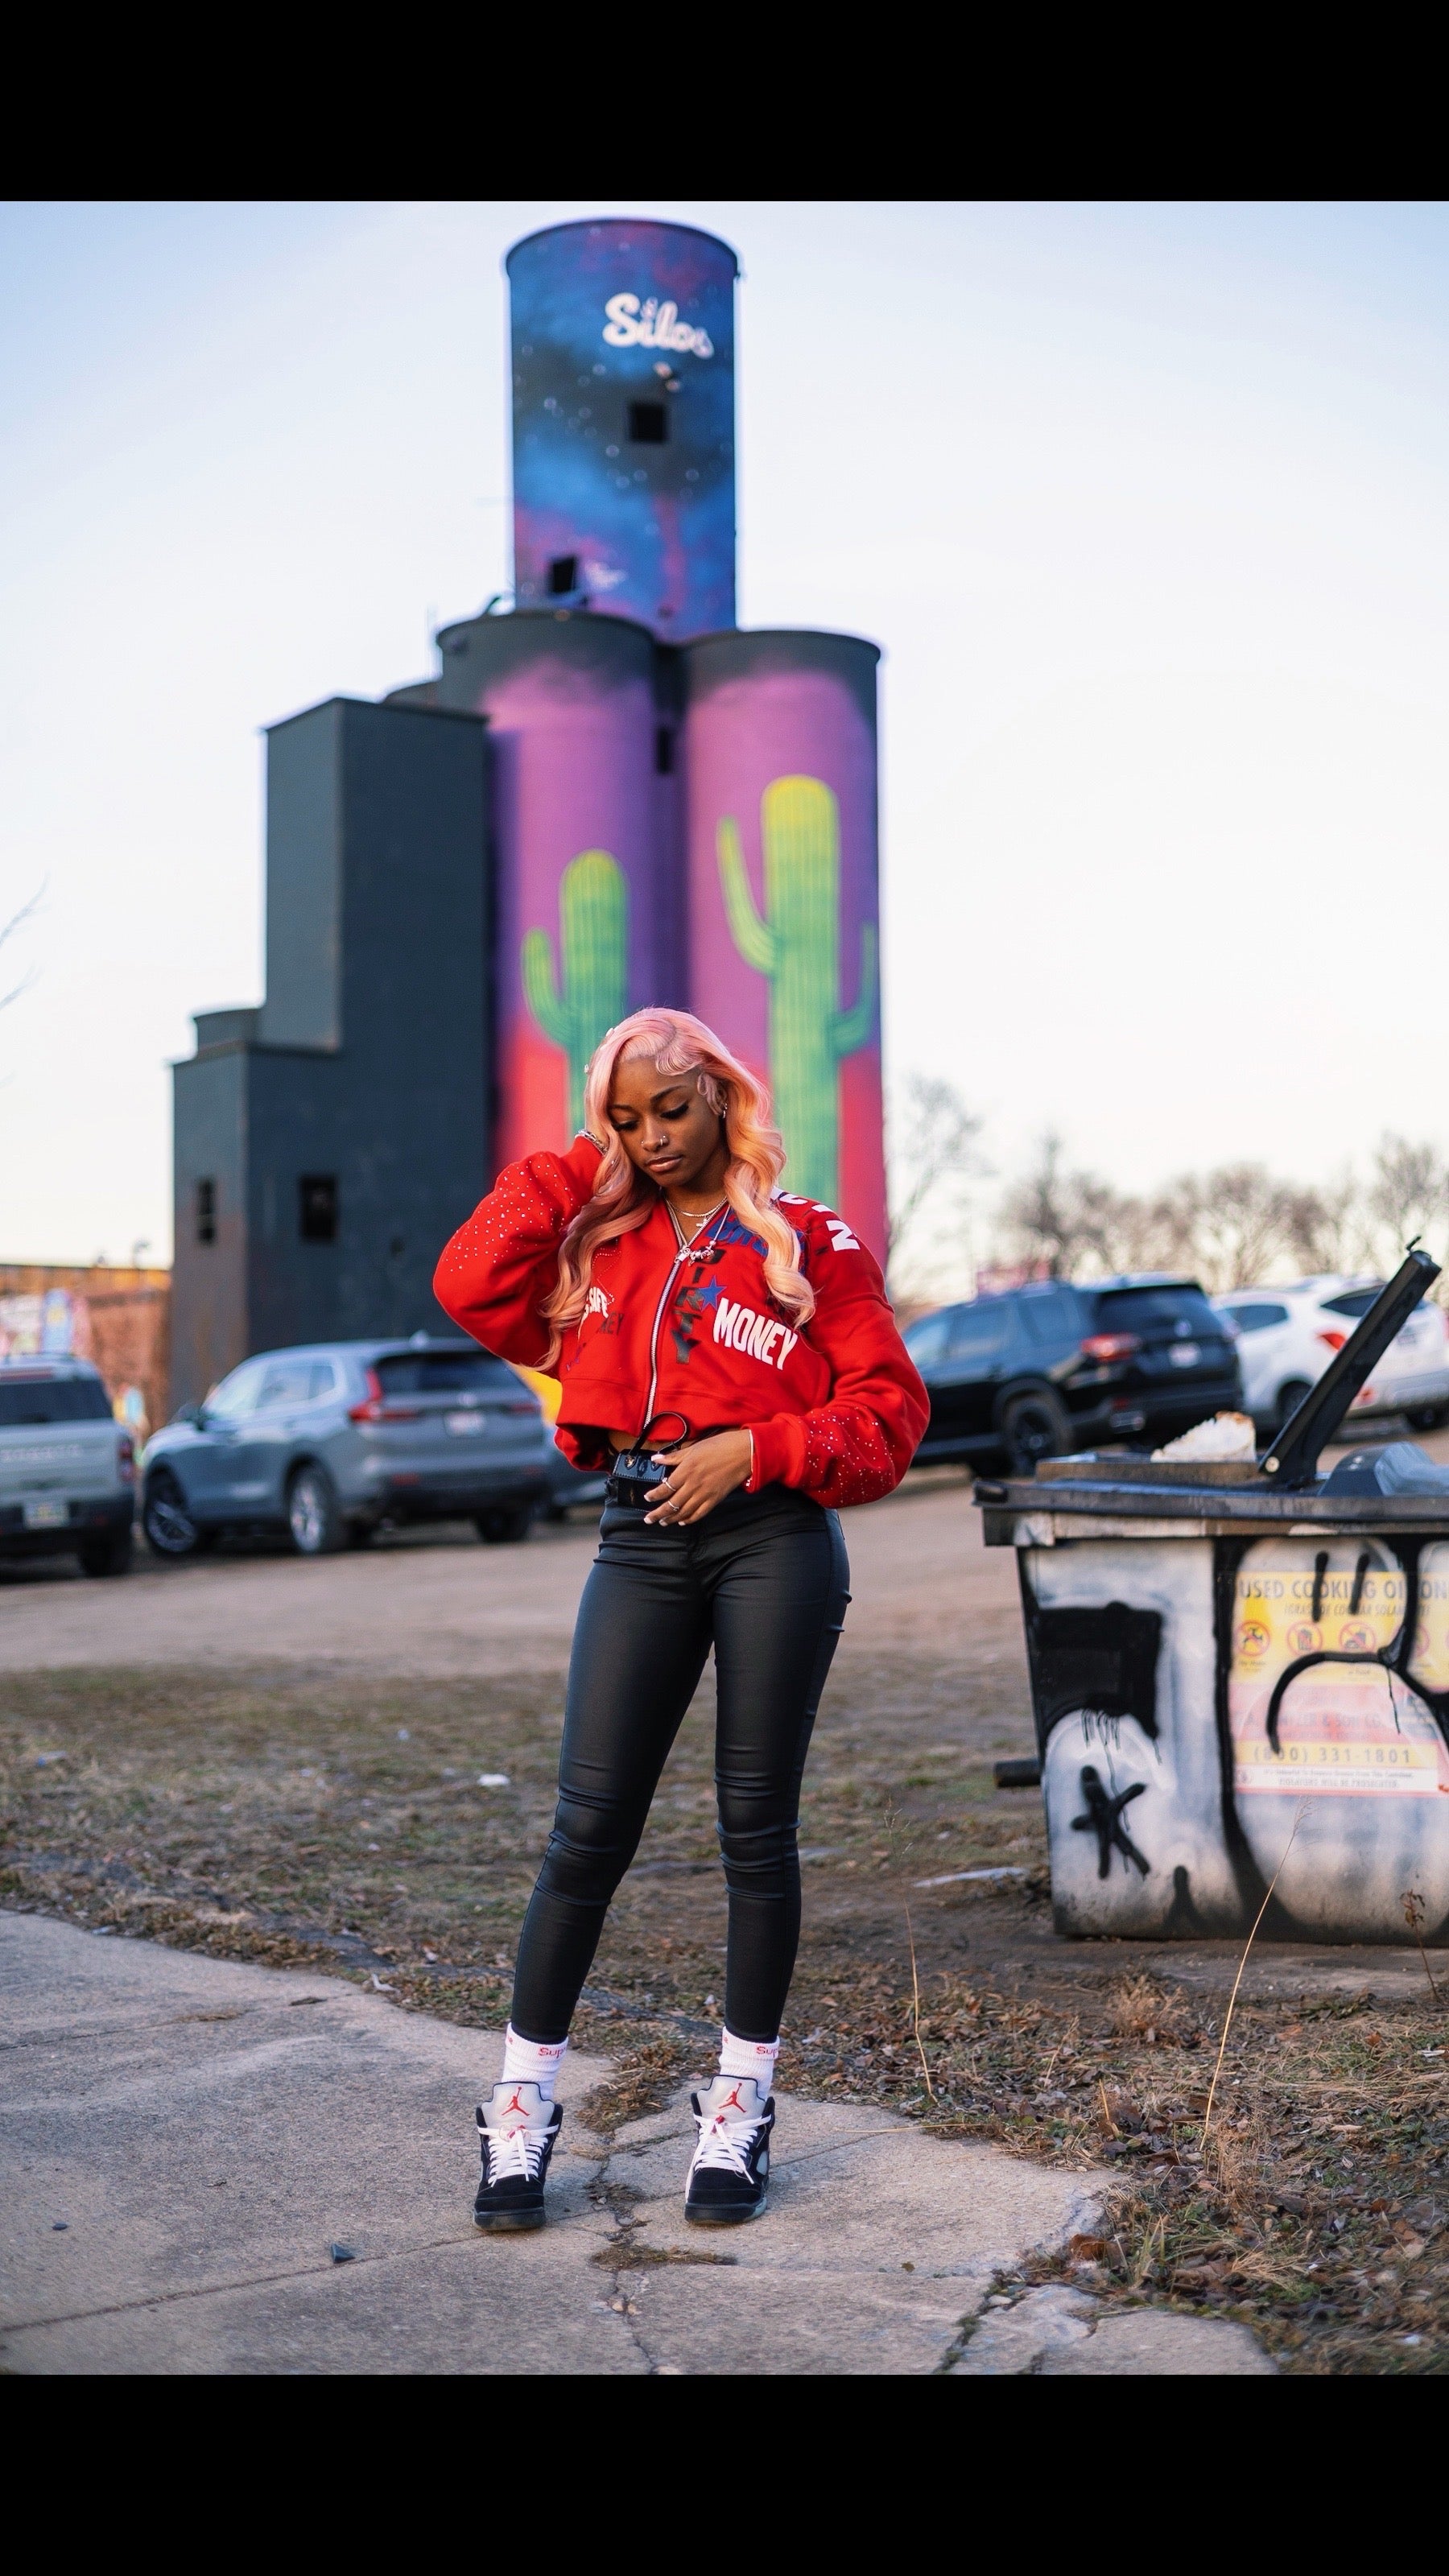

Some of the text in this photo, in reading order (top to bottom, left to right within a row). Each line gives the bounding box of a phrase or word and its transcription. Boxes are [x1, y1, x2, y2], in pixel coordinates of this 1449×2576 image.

[712, 1297, 799, 1371] MONEY
[1240, 1579, 1285, 1600] USED
[1291, 1580, 1377, 1600] COOKIG
[1319, 1746, 1411, 1764] 331-1801
